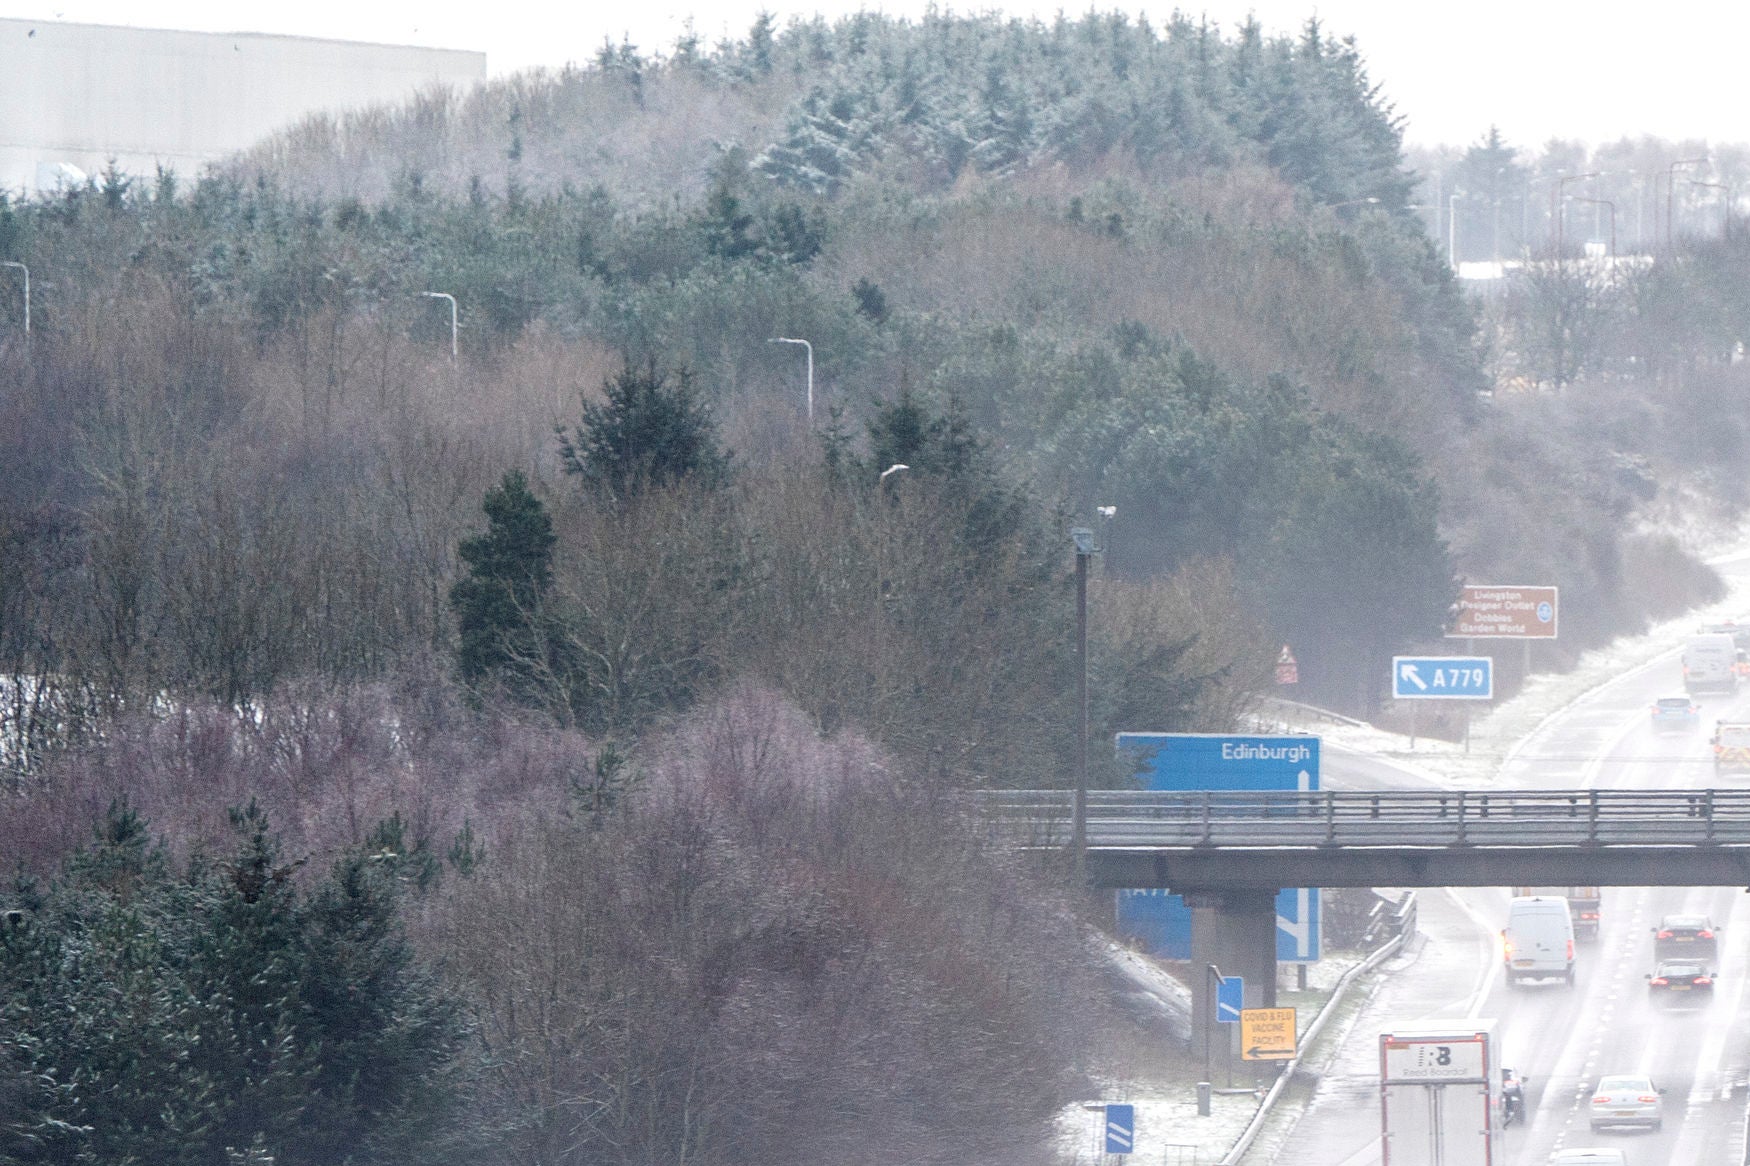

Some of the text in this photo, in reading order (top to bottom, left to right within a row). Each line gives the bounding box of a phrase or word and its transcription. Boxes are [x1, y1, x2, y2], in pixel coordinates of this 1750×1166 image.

[1474, 591, 1521, 601] Livingston
[1460, 601, 1535, 610] Designer Outlet
[1474, 613, 1512, 622] Dobbies
[1460, 623, 1526, 633] Garden World
[1432, 668, 1484, 688] A779
[1222, 742, 1310, 763] Edinburgh
[1243, 1012, 1268, 1022] COVID
[1252, 1023, 1285, 1033] VACCINE
[1252, 1035, 1286, 1045] FACILITY
